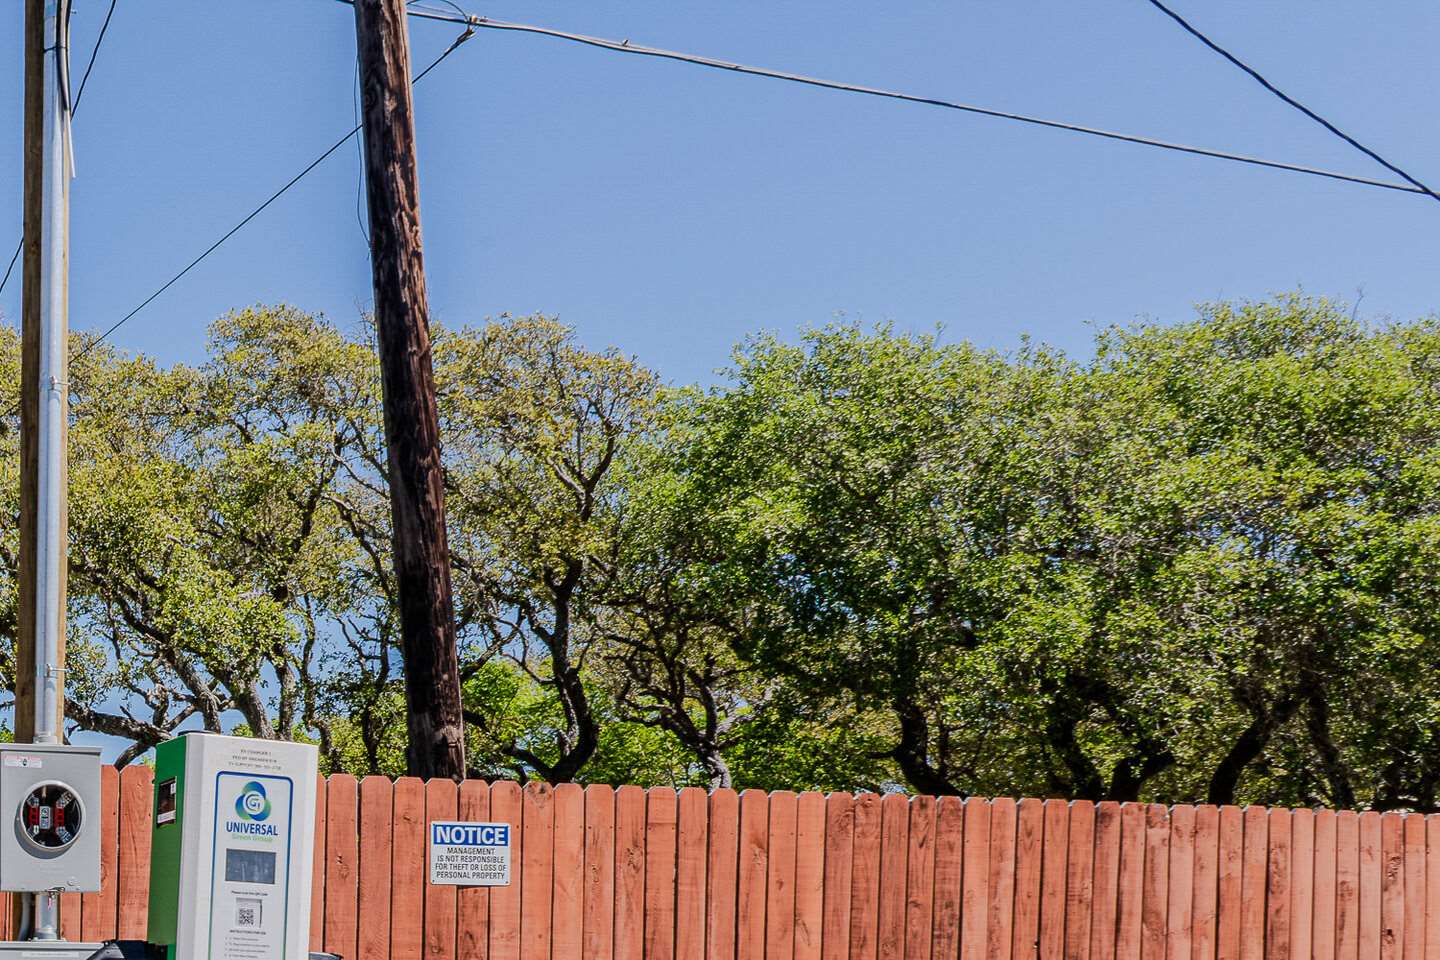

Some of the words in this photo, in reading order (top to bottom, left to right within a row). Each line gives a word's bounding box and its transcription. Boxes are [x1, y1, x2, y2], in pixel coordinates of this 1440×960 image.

[226, 821, 279, 836] UNIVERSAL
[436, 826, 506, 845] NOTICE
[446, 847, 496, 855] MANAGEMENT
[445, 855, 459, 863] NOT
[460, 856, 505, 864] RESPONSIBLE
[435, 863, 448, 871] FOR
[449, 863, 469, 871] THEFT
[480, 864, 497, 872] LOSS
[498, 864, 507, 872] OF
[436, 871, 470, 879] PERSONAL
[471, 871, 505, 880] PROPERTY
